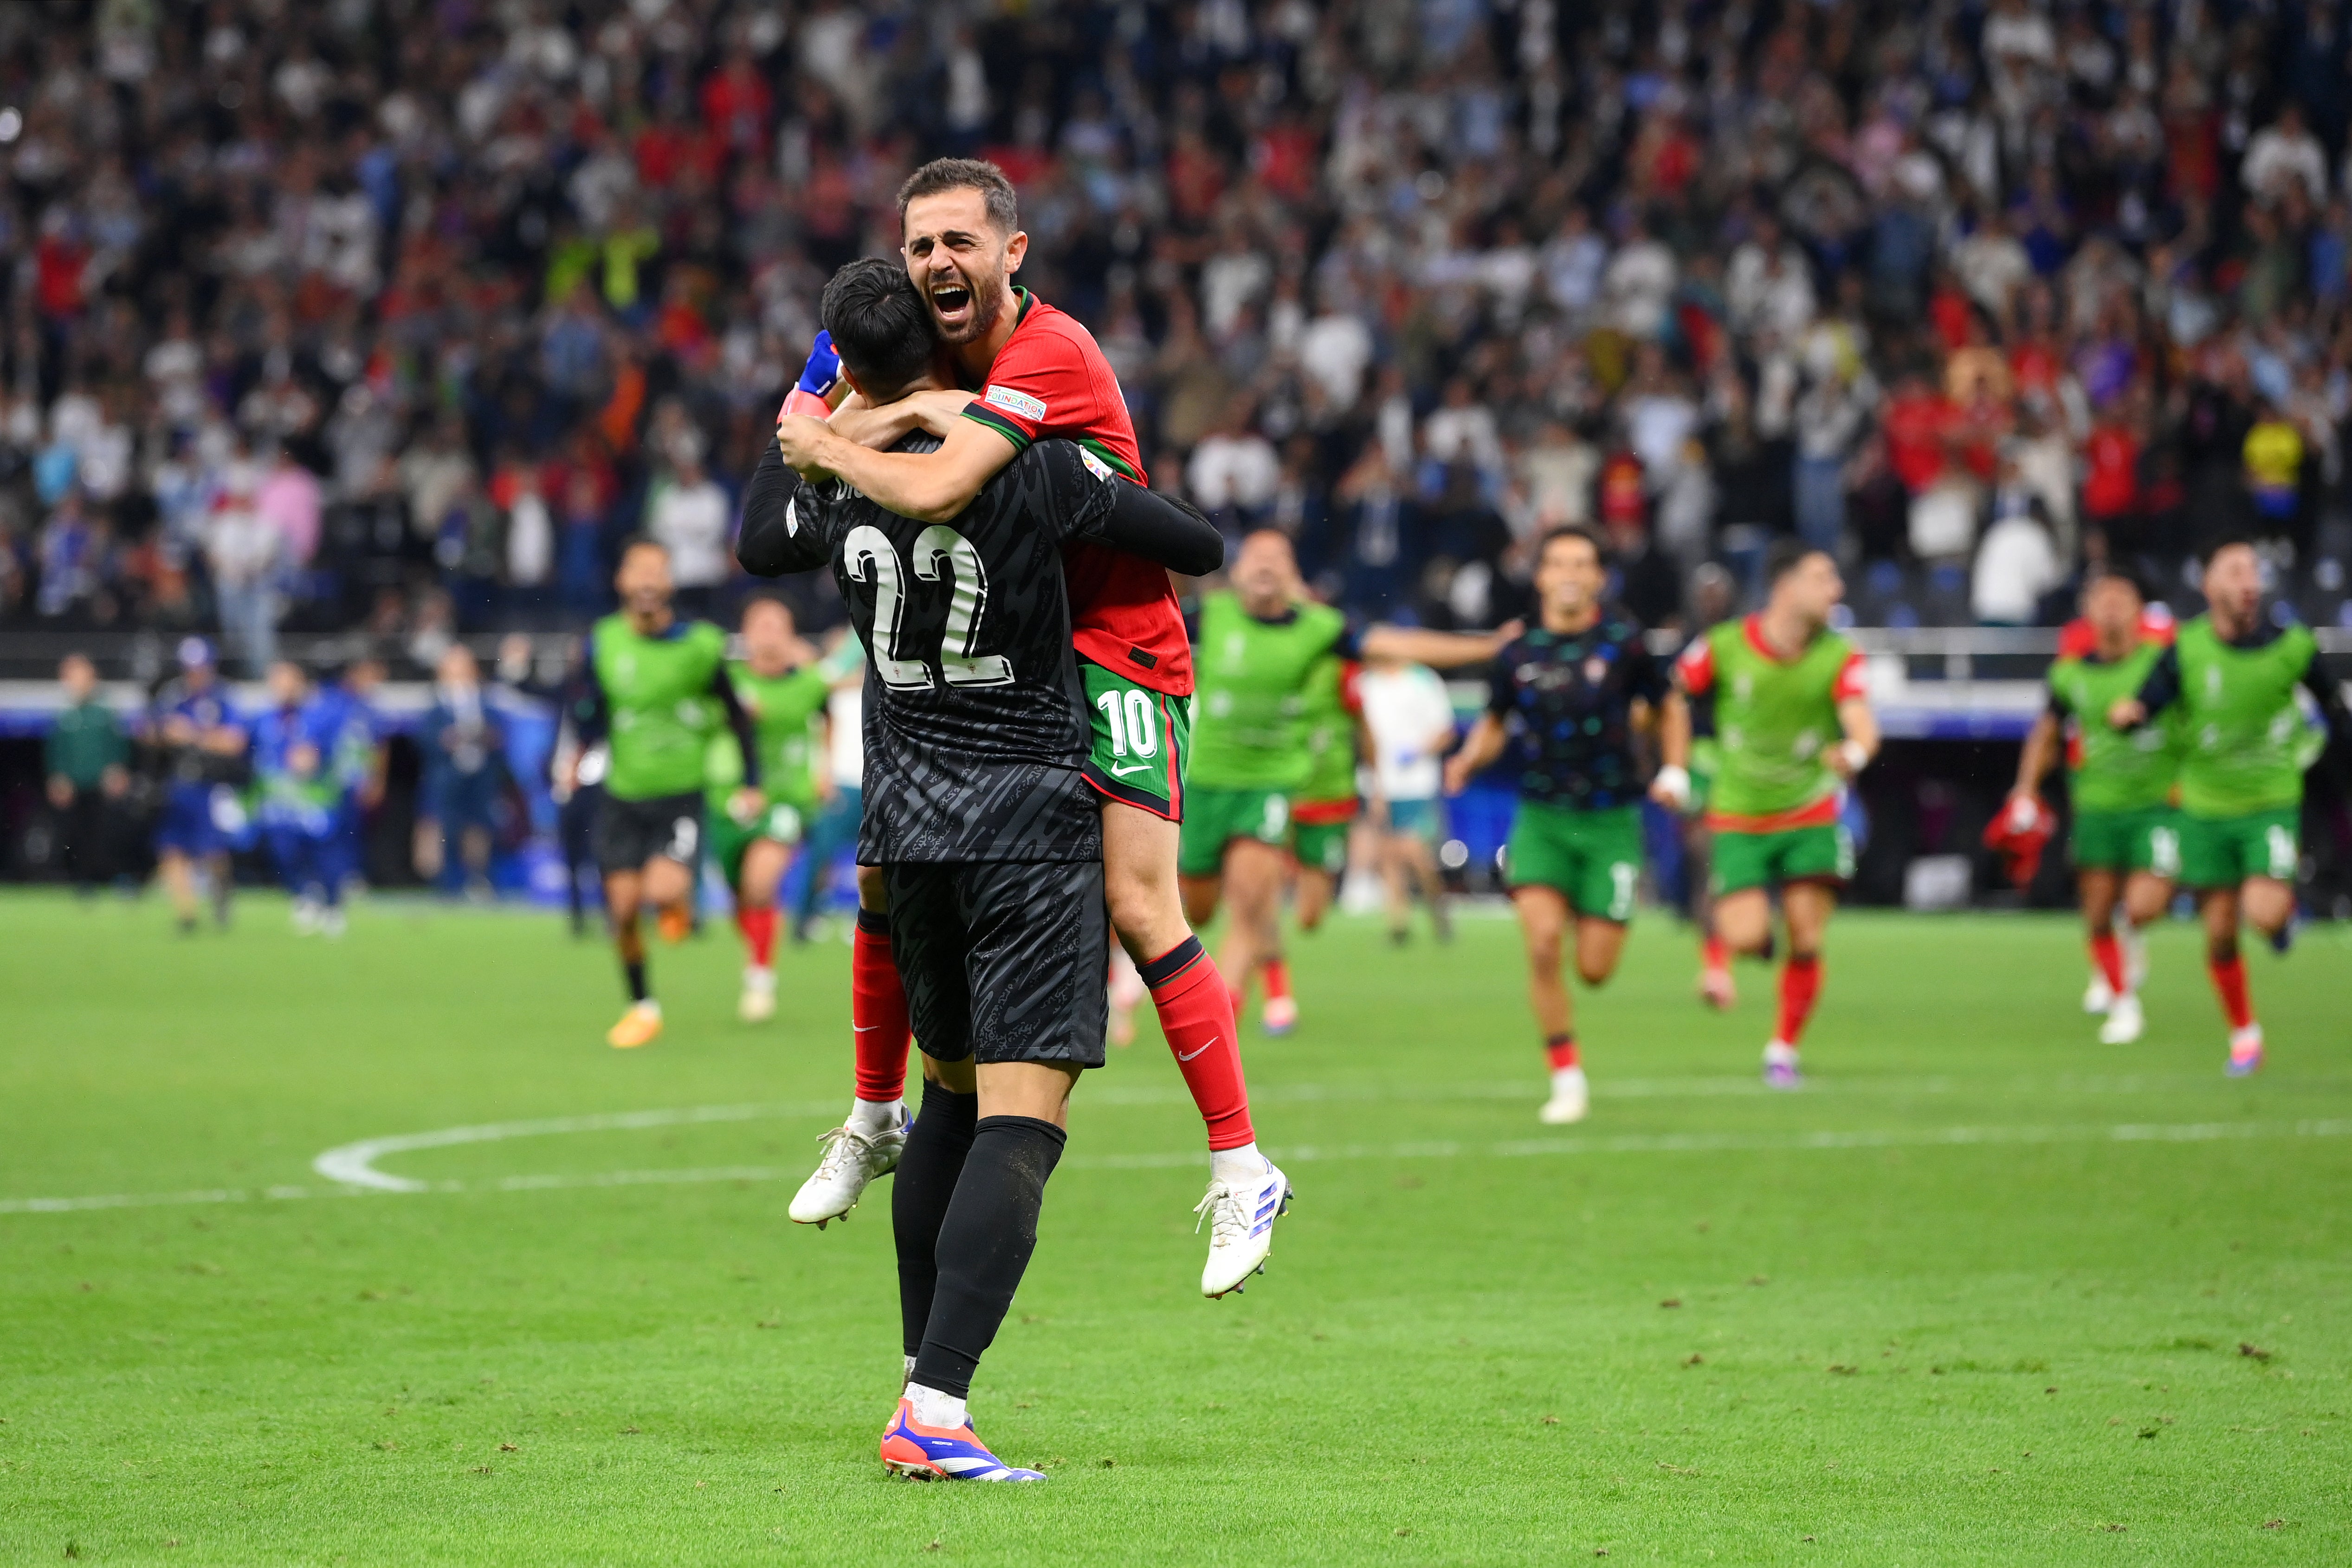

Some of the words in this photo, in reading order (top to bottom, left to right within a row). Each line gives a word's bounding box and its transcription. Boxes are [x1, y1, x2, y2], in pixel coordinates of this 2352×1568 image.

[988, 392, 1043, 416] FOUNDATION
[844, 525, 1015, 691] 22
[1097, 689, 1157, 758] 10
